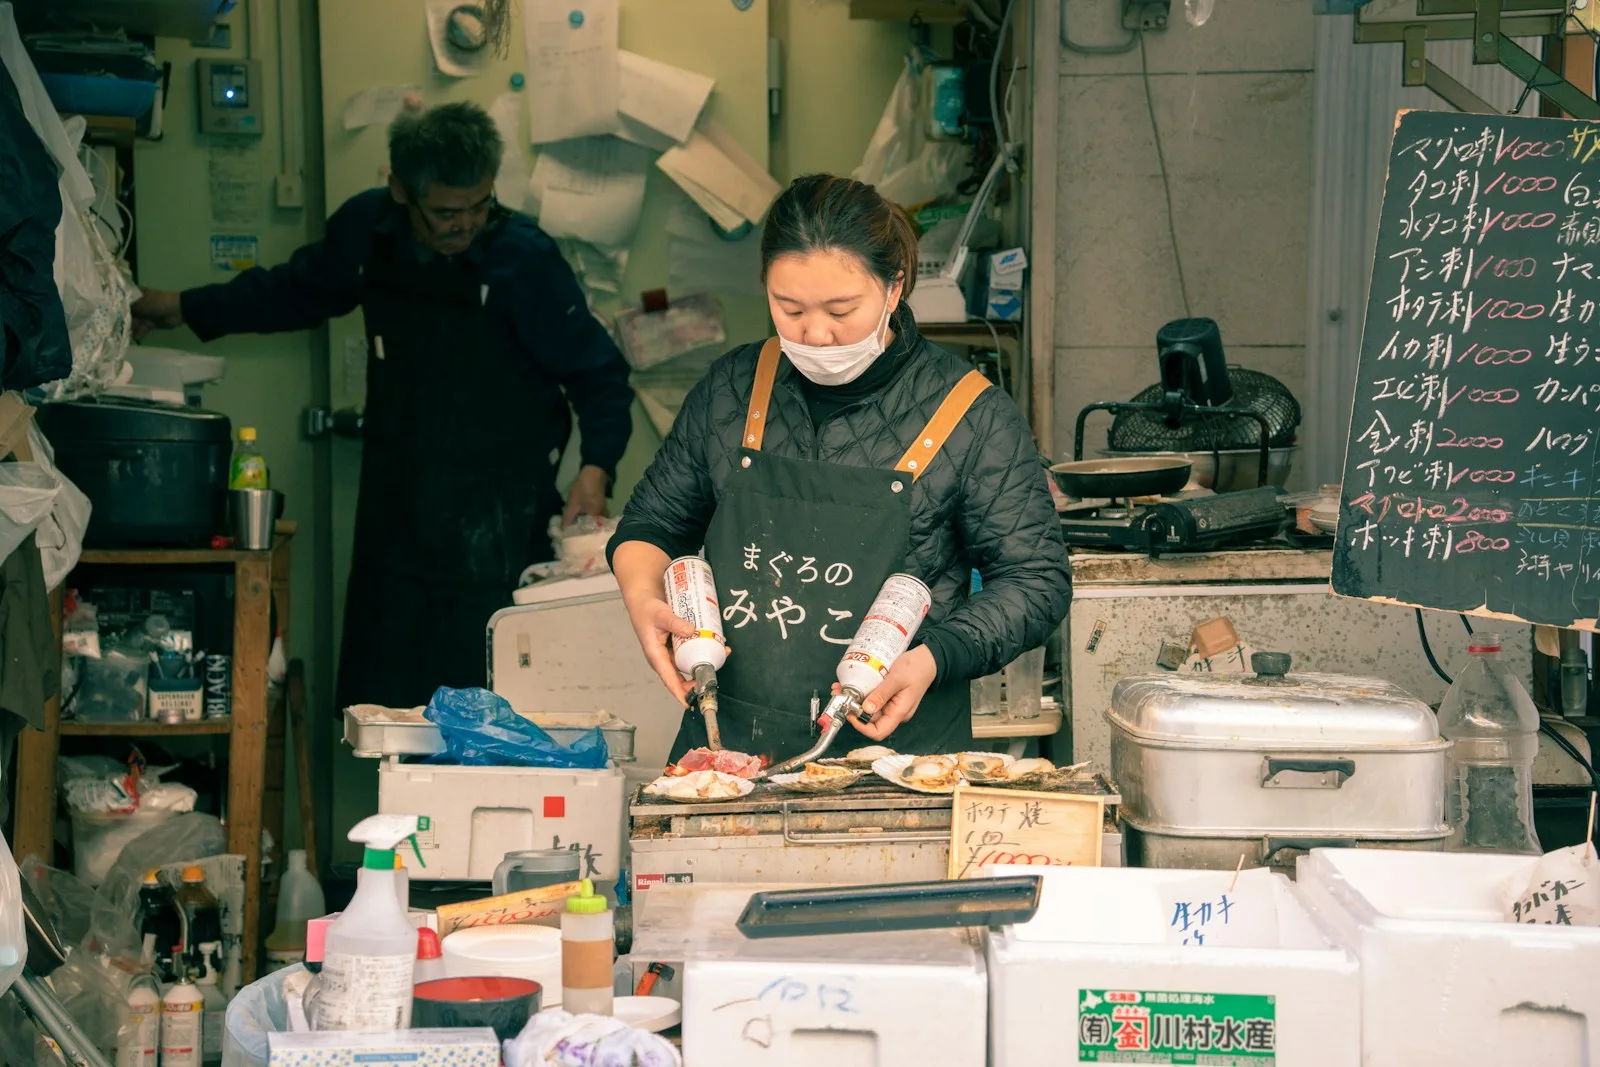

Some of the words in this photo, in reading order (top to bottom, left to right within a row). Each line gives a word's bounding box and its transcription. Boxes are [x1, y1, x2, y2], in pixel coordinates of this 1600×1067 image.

[1483, 172, 1557, 194] 1000
[1481, 211, 1556, 234] 1000
[1474, 255, 1536, 279] 1000
[1552, 252, 1600, 283] ナマ
[1471, 298, 1545, 319] 1000
[1457, 344, 1532, 364] 1000
[1446, 385, 1520, 404] 1000
[1436, 428, 1504, 449] 2000
[1451, 468, 1515, 484] 1000
[1444, 497, 1508, 523] 2000
[1455, 530, 1510, 553] 800
[743, 542, 853, 587] まぐろの
[722, 588, 853, 645] みやこ
[206, 655, 227, 716] BLACK
[1153, 1016, 1274, 1050] 川村水産
